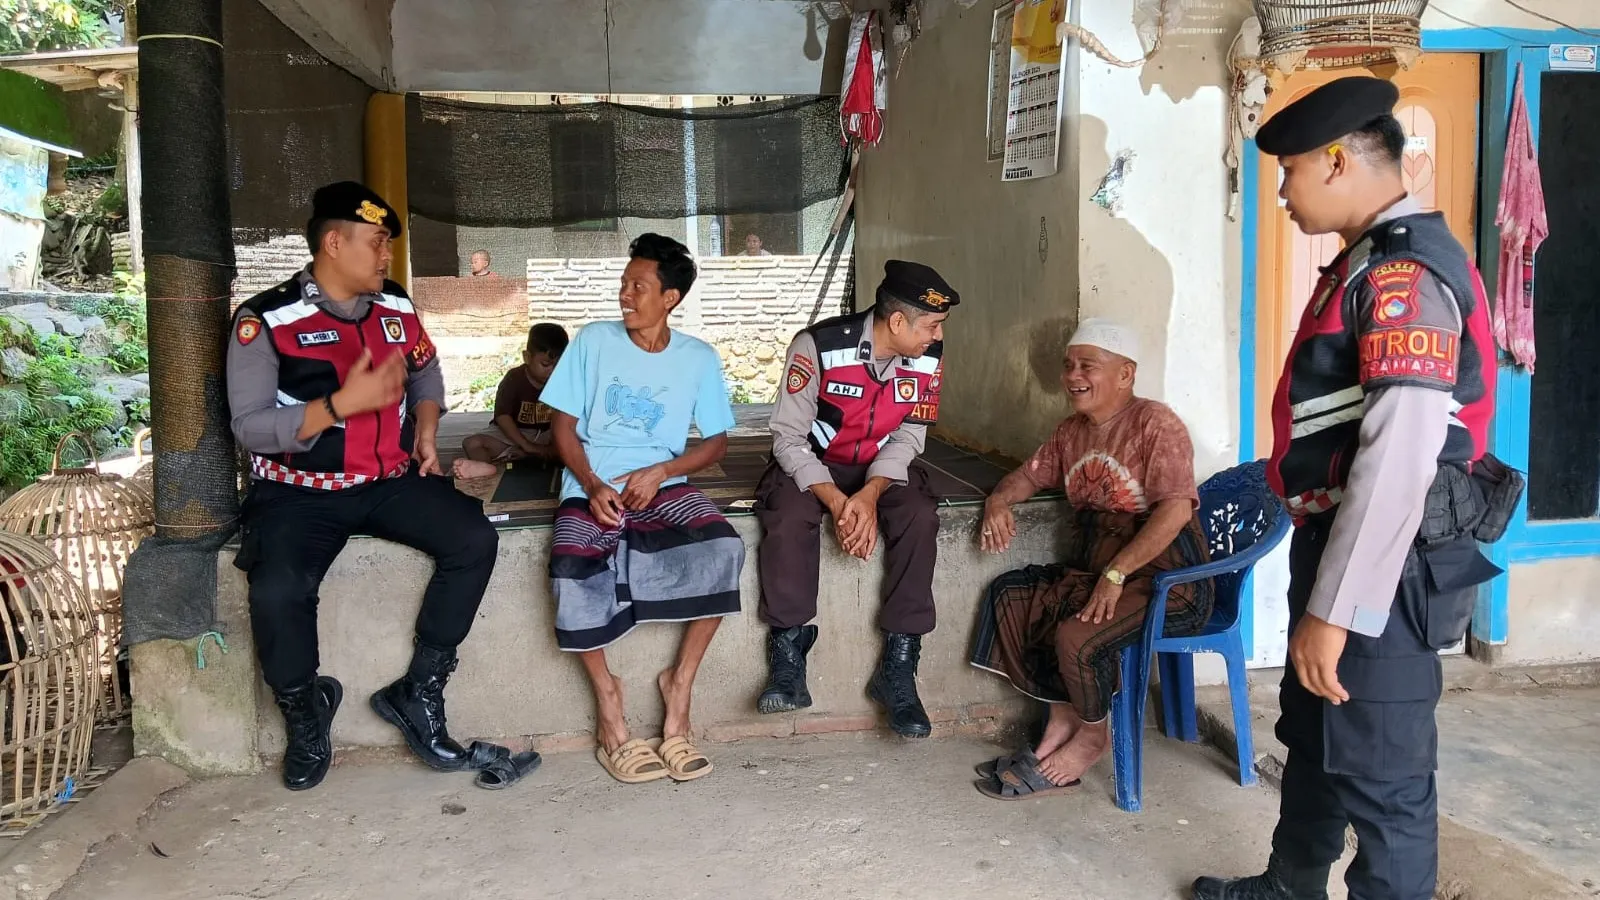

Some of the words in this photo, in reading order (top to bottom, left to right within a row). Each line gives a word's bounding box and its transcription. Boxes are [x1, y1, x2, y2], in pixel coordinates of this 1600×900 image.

[1375, 263, 1416, 277] POLRES
[1368, 359, 1453, 378] SAMAPTA
[832, 383, 859, 396] AHJ
